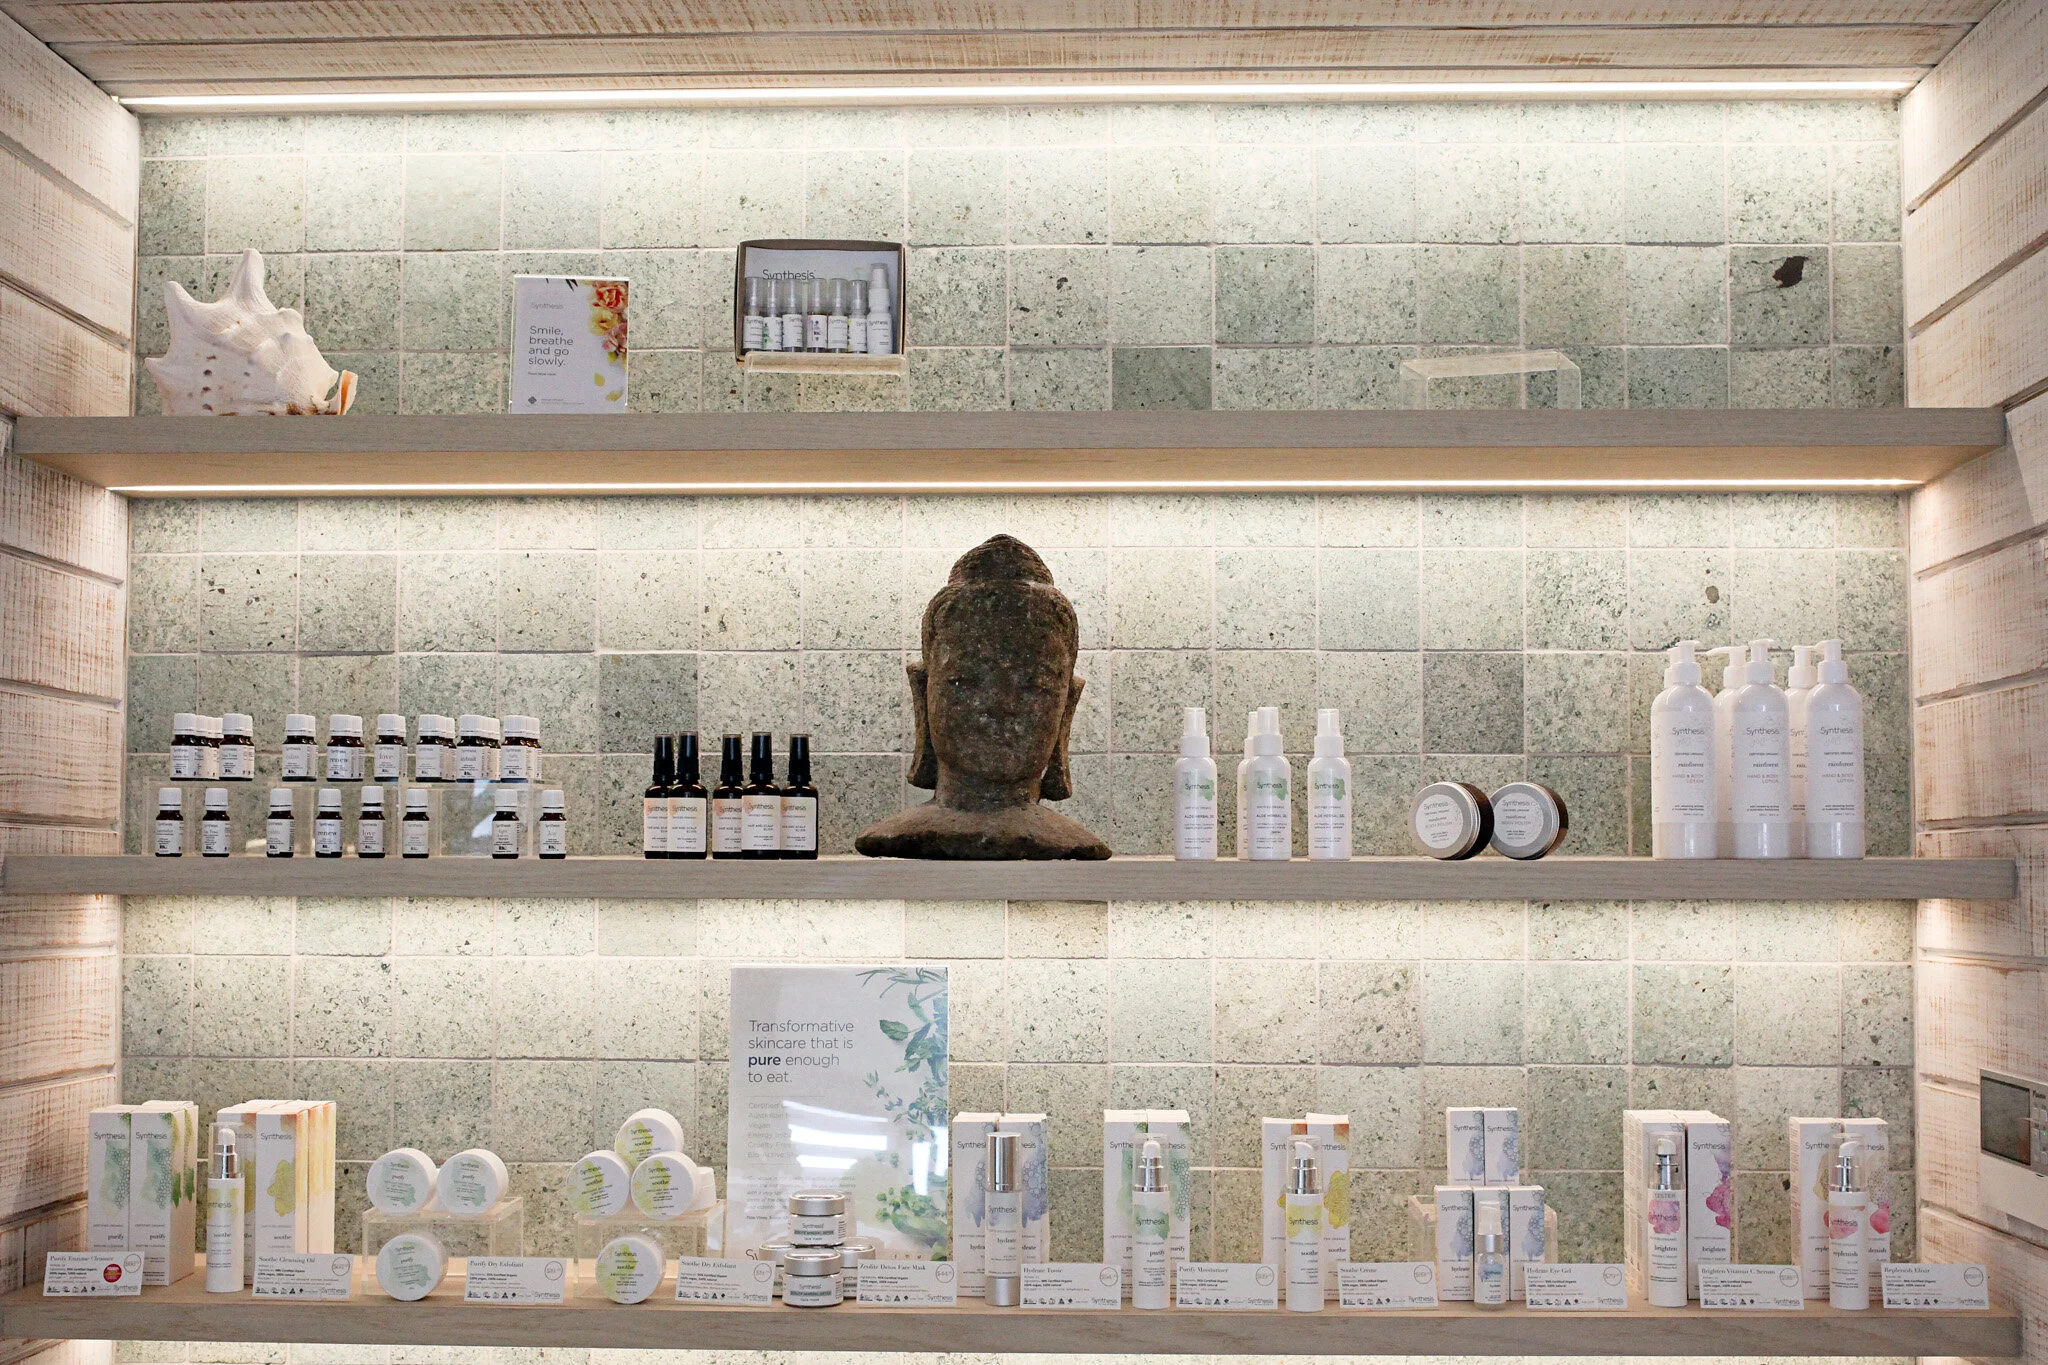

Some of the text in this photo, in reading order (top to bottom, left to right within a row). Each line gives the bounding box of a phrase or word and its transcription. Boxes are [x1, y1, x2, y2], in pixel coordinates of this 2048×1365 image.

[529, 325, 564, 336] Smile,
[529, 336, 574, 346] breathe
[528, 346, 570, 356] and go
[528, 357, 566, 367] slowly.
[1672, 727, 1704, 736] Synthesis
[1746, 727, 1780, 736] Synthesis
[1820, 727, 1853, 735] Synthesis
[748, 1019, 854, 1033] Transformative
[748, 1037, 854, 1049] skincare that is
[748, 1053, 840, 1068] pure enough
[748, 1072, 792, 1083] to eat.
[94, 1132, 126, 1140] Synthesis
[136, 1132, 167, 1140] Synthesis
[261, 1132, 292, 1140] Synthesis
[958, 1141, 986, 1149] Synthesi
[1110, 1141, 1133, 1150] Synthe
[1692, 1142, 1725, 1150] Synthesis
[1805, 1142, 1829, 1150] Synthe
[1136, 1216, 1165, 1226] Synthesis
[1289, 1217, 1318, 1226] Synthesis
